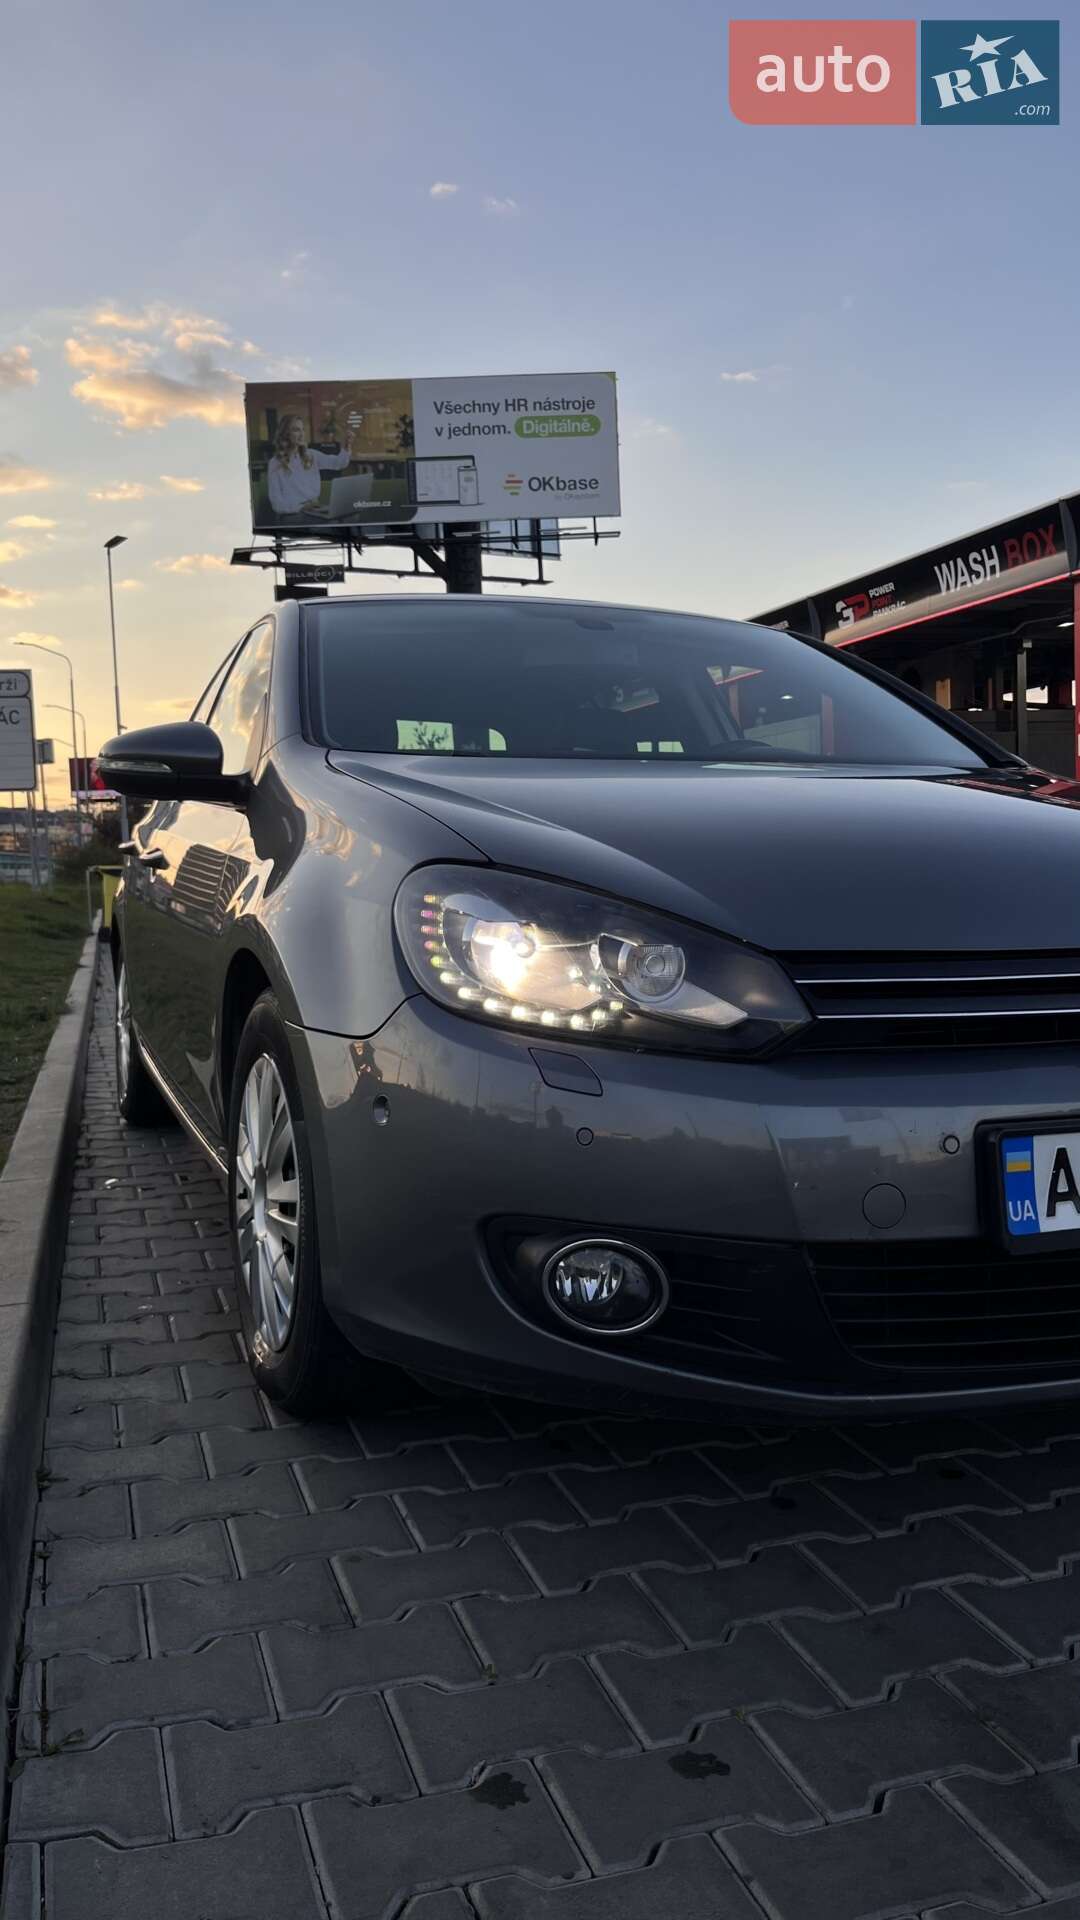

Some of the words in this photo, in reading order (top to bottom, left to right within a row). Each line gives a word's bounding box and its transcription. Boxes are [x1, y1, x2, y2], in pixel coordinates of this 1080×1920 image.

[433, 400, 500, 416] Všechny
[504, 398, 528, 413] HR
[533, 396, 596, 413] nástroje
[434, 426, 444, 437] v
[447, 422, 511, 440] jednom.
[523, 418, 596, 436] Digitálně.
[528, 476, 600, 492] OKbase
[933, 544, 1000, 596] WASH
[1004, 523, 1057, 569] BOX
[868, 582, 895, 598] POWER
[1009, 1199, 1036, 1221] UA
